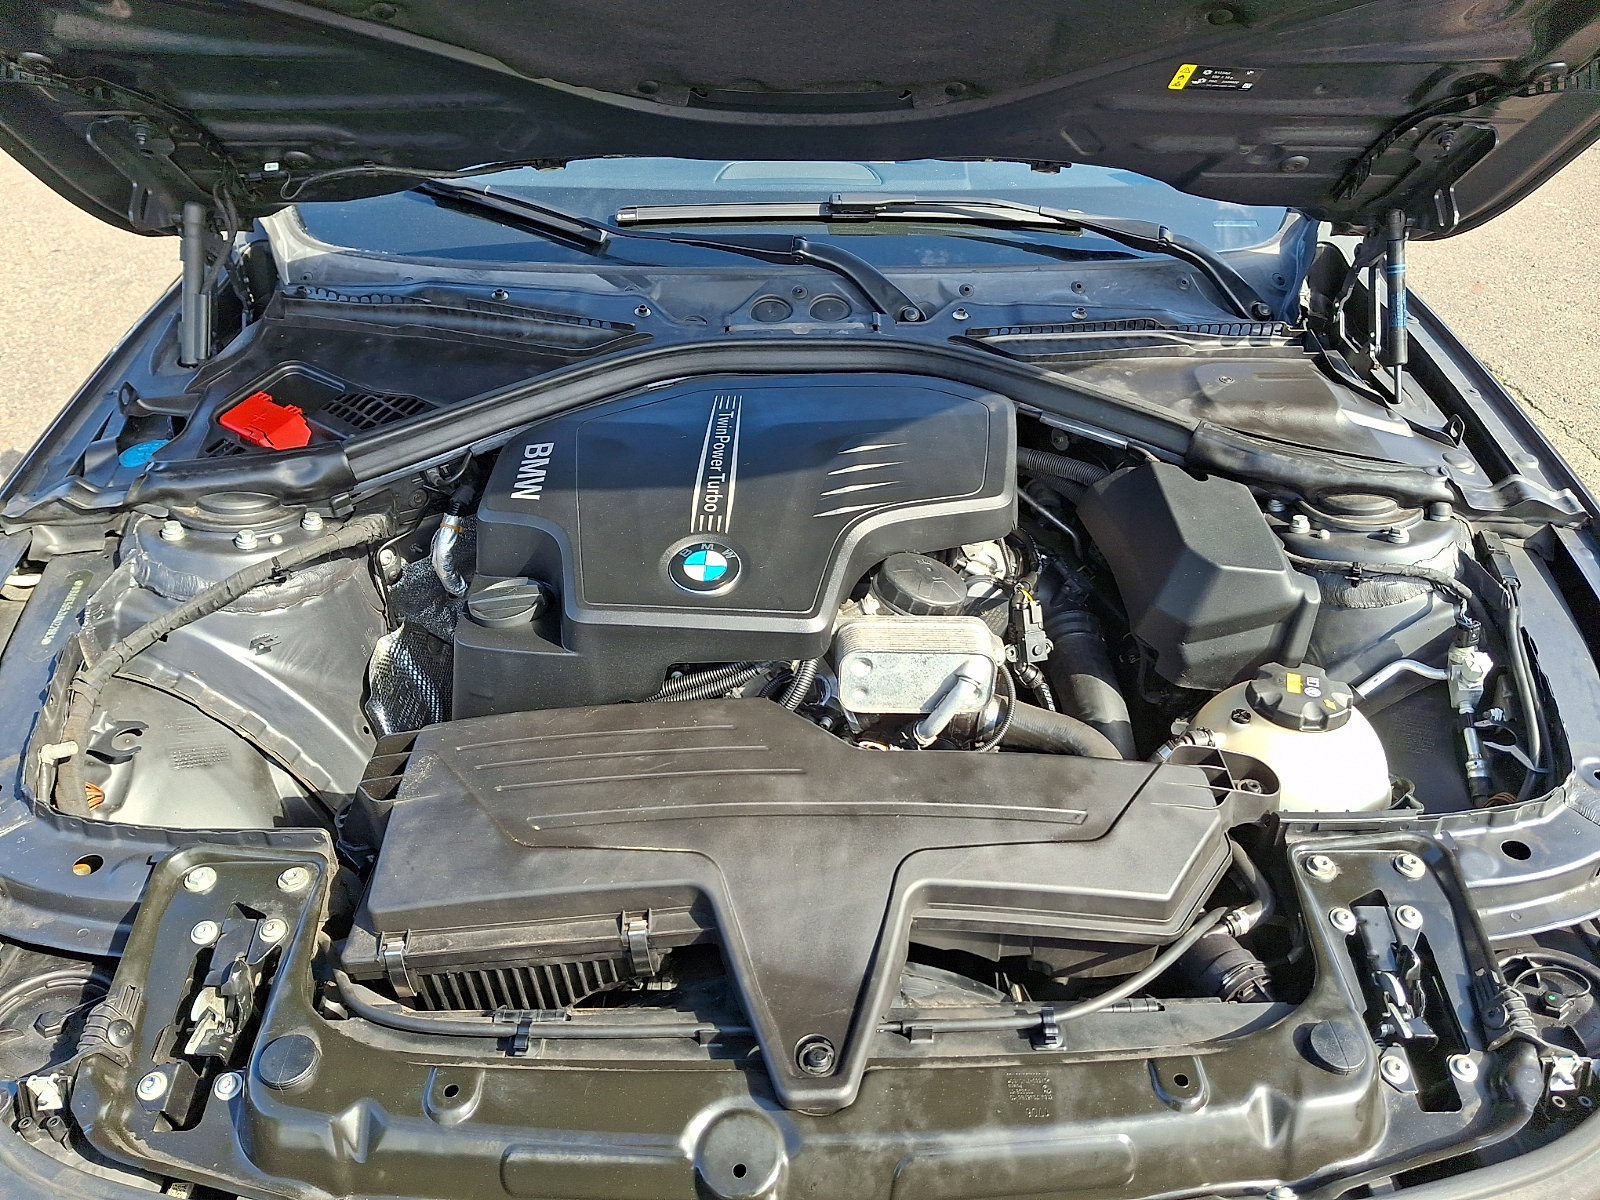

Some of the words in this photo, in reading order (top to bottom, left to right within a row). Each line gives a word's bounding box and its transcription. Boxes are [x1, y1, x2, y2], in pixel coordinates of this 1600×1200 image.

[709, 411, 734, 472] TwinPower
[510, 442, 554, 501] BMW
[703, 473, 725, 513] Turbo
[679, 542, 737, 559] BMW
